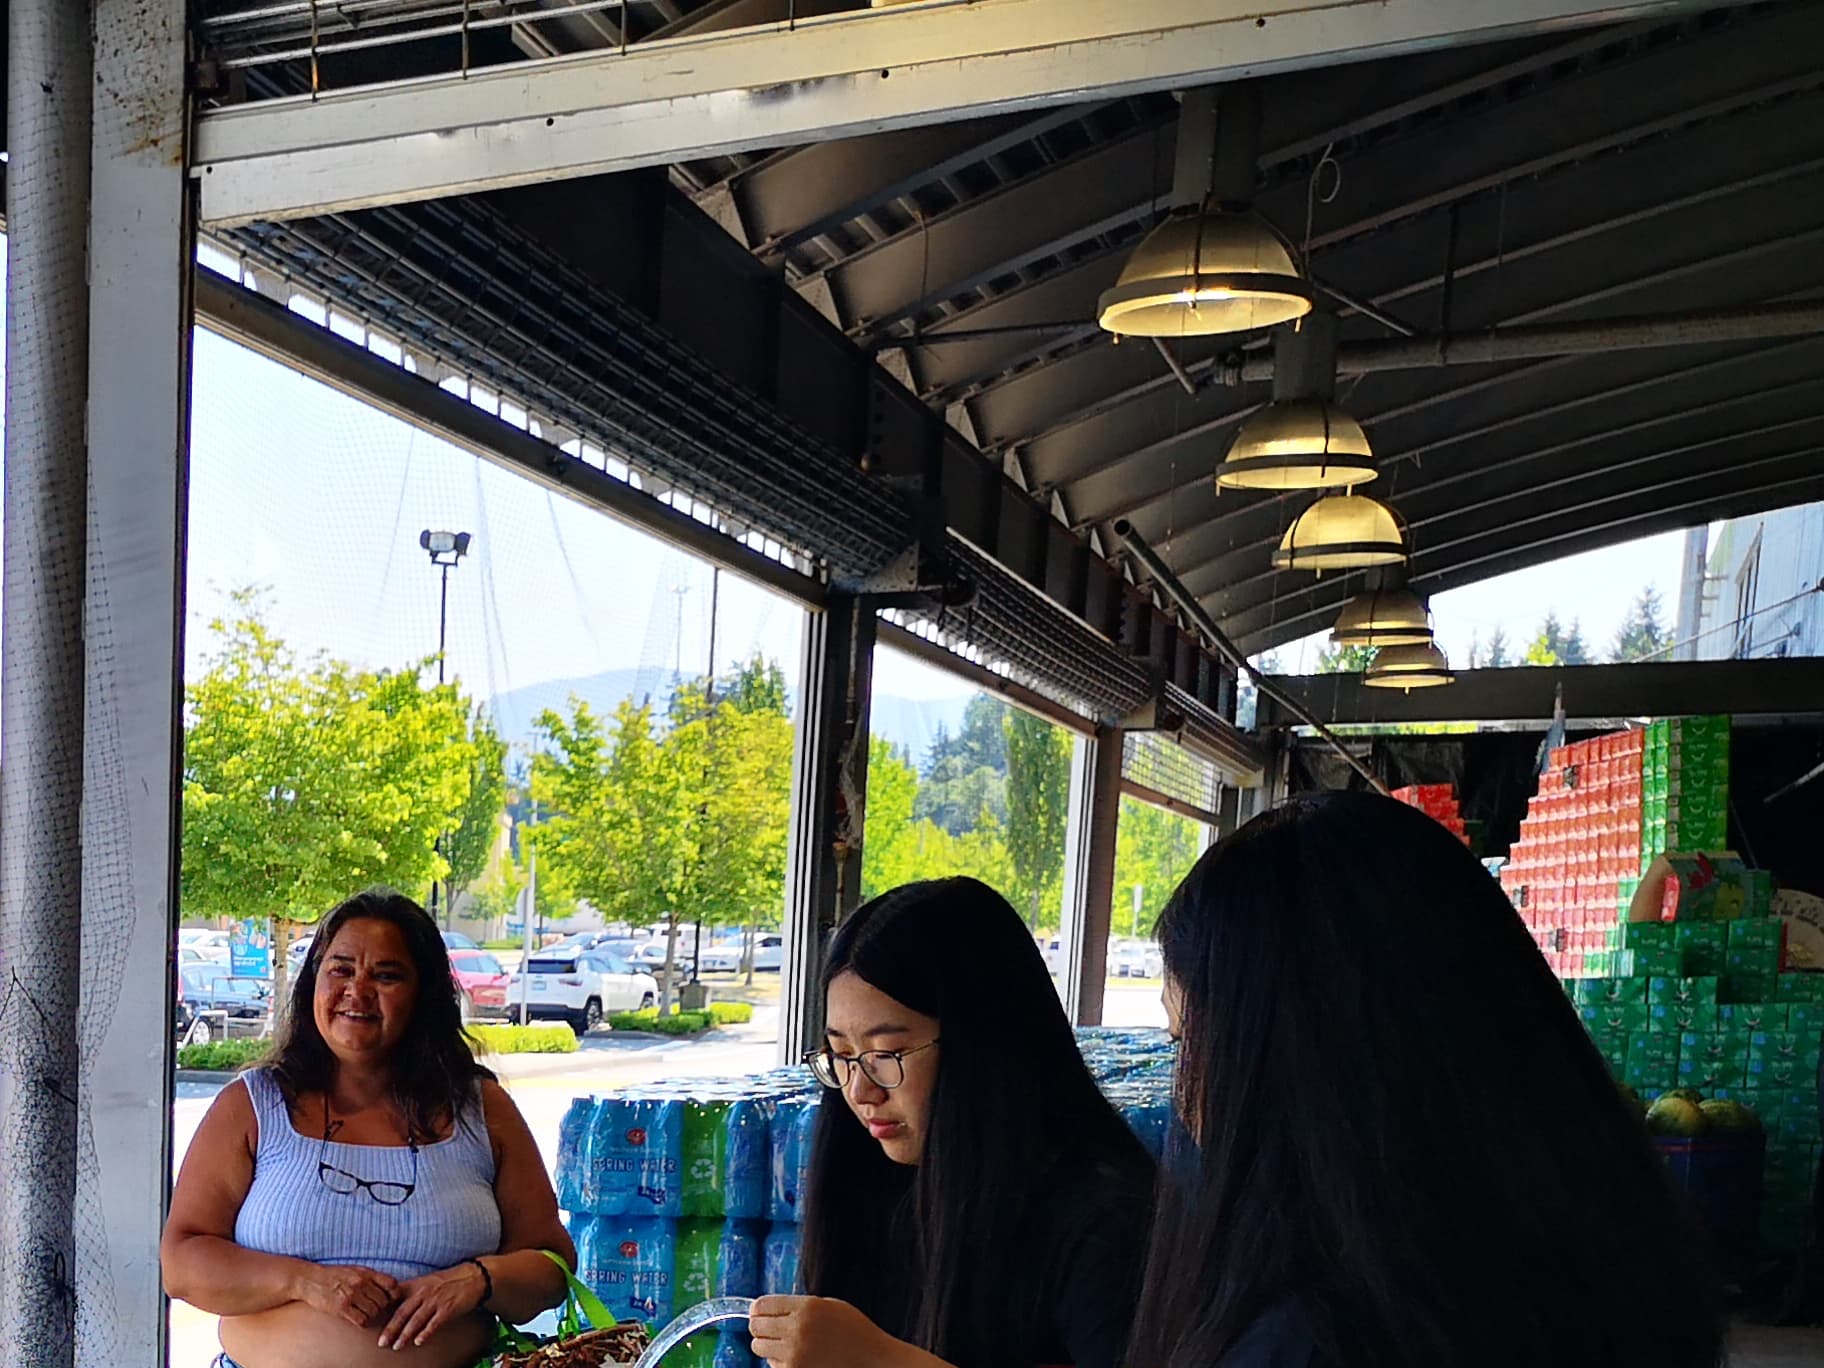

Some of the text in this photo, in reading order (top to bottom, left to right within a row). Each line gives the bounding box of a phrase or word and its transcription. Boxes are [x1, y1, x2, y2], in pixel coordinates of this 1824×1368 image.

[592, 1157, 676, 1173] SPRING WATER
[584, 1269, 668, 1286] SPRING WATER
